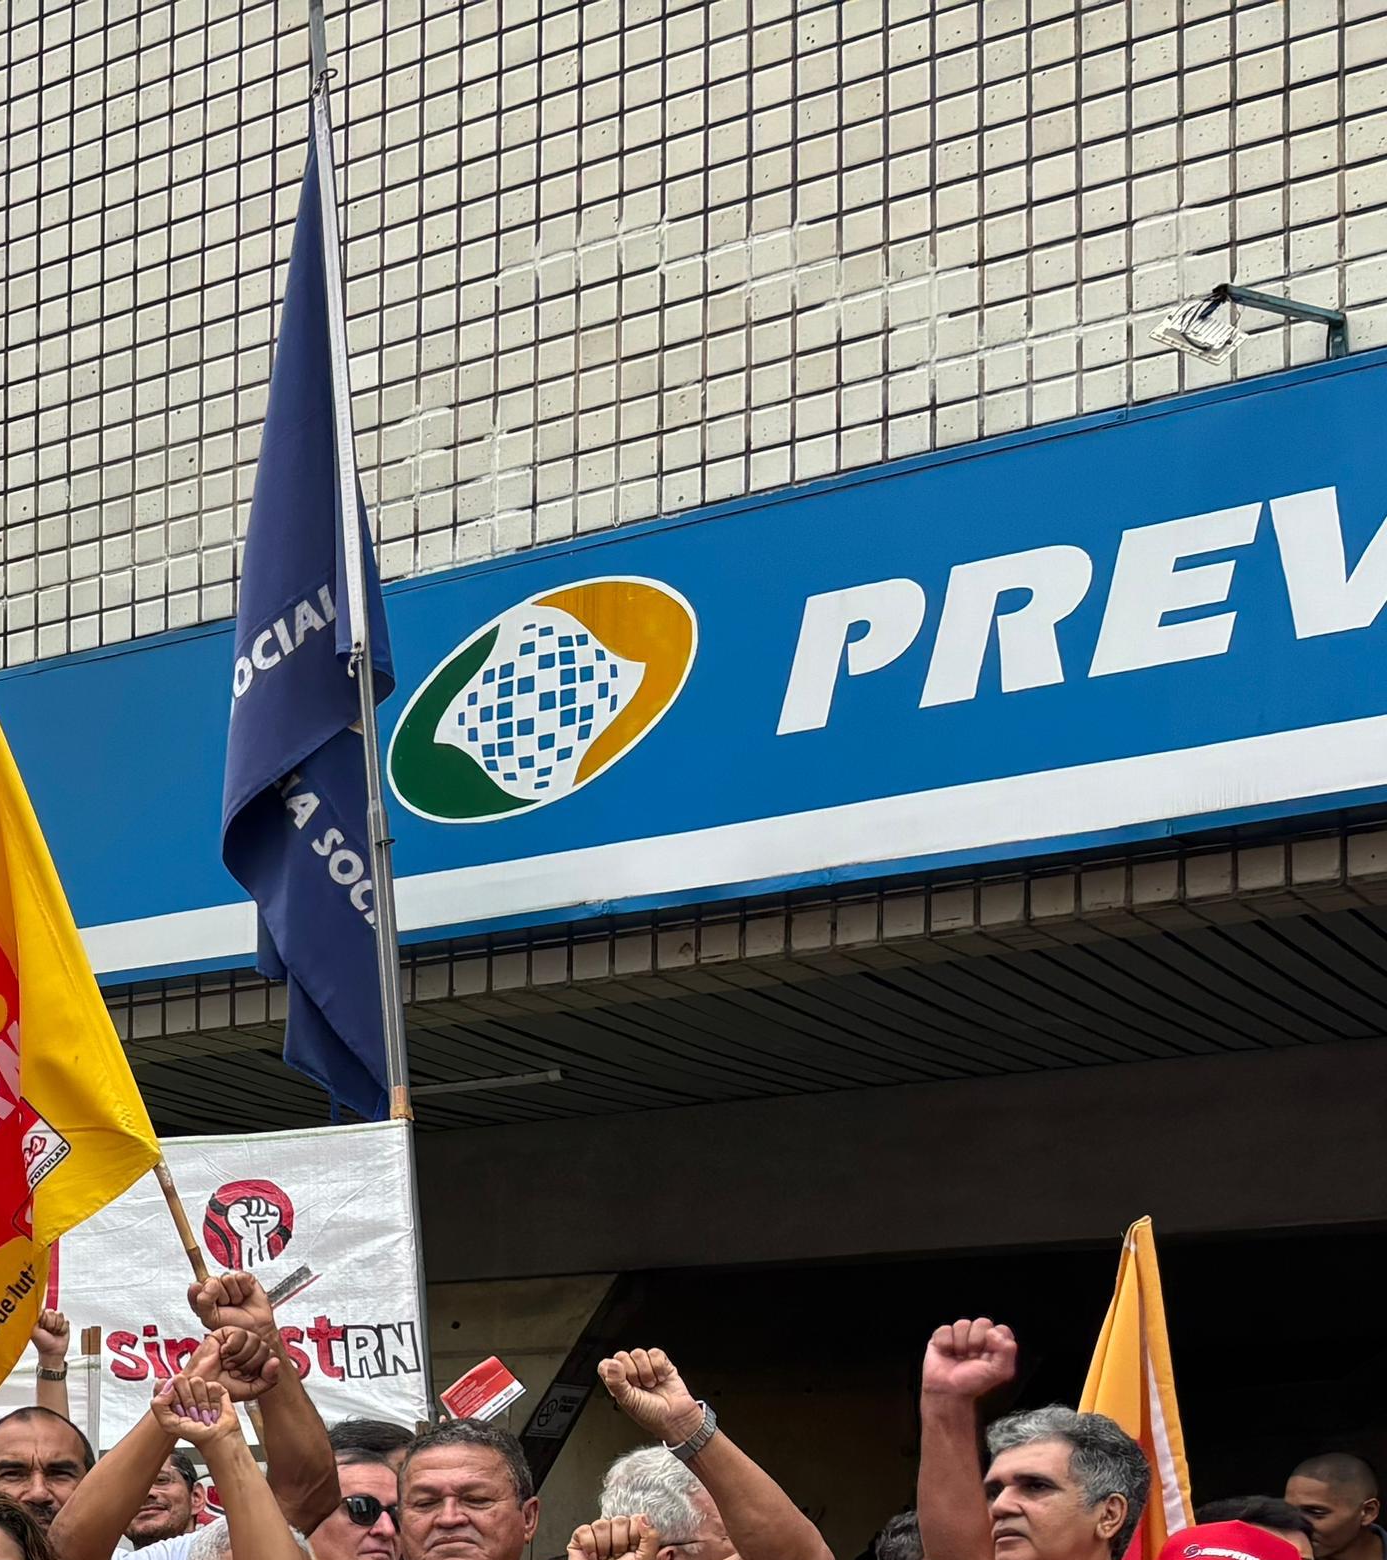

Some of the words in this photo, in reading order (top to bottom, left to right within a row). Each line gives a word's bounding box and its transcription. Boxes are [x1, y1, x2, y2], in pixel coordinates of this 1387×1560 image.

[776, 486, 1387, 735] PREV
[311, 827, 376, 930] SOC
[7, 1263, 36, 1301] lut
